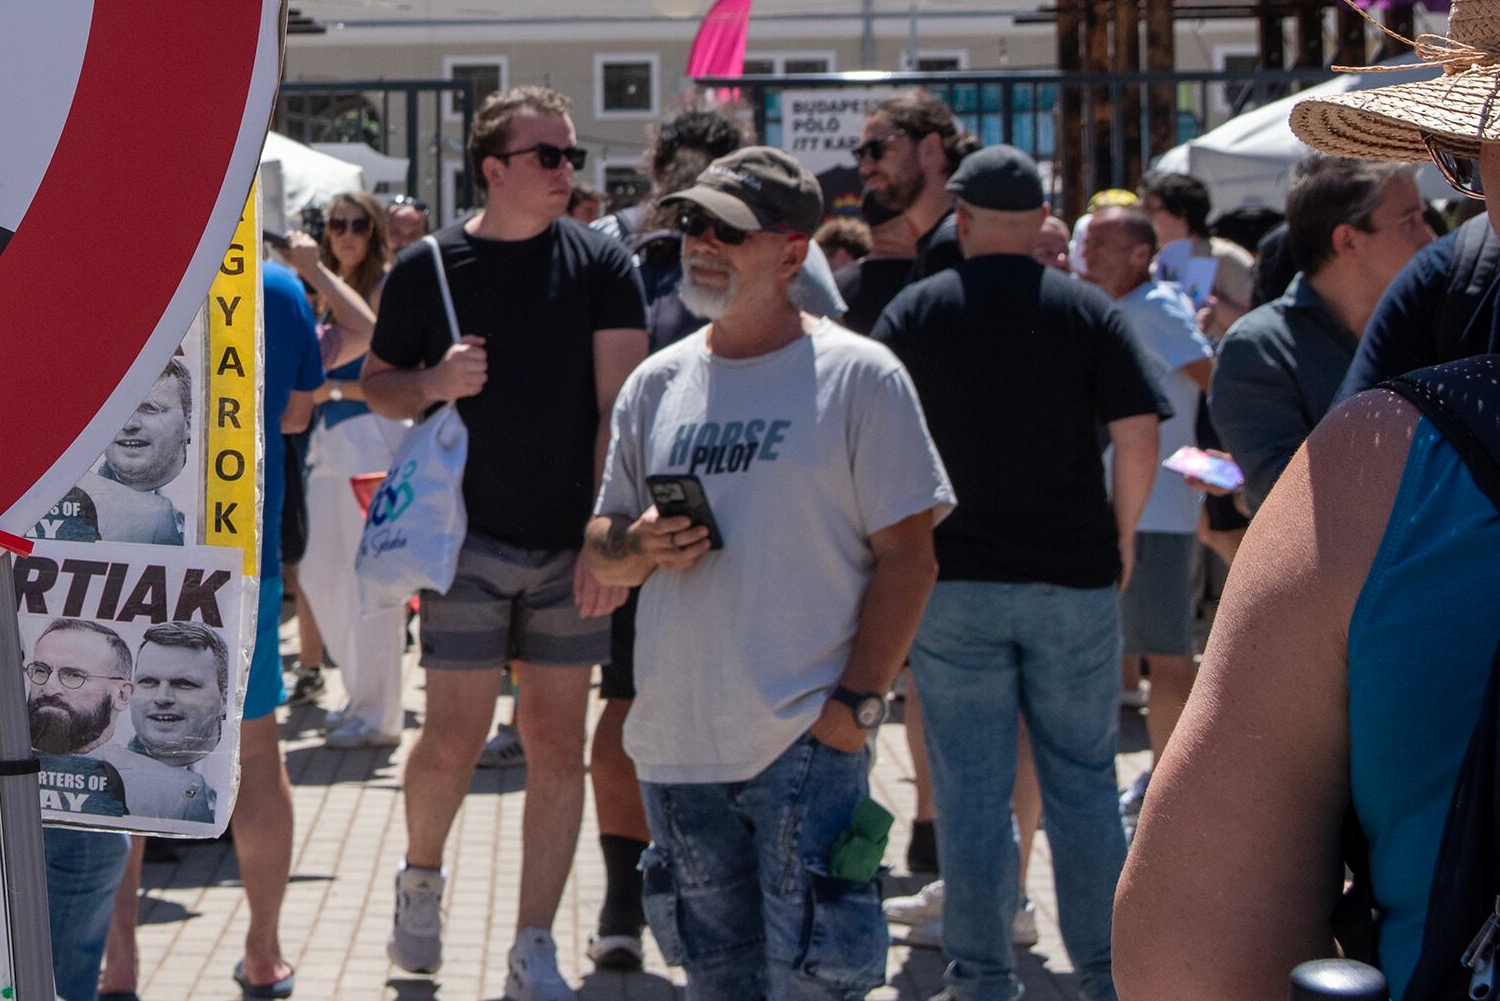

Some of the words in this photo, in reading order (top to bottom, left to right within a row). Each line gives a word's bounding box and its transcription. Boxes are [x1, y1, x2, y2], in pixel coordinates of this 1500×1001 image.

[213, 217, 245, 536] GYAROK
[668, 419, 791, 466] HORSE
[690, 442, 758, 475] PILOT
[62, 501, 81, 517] OF
[88, 775, 108, 791] OF
